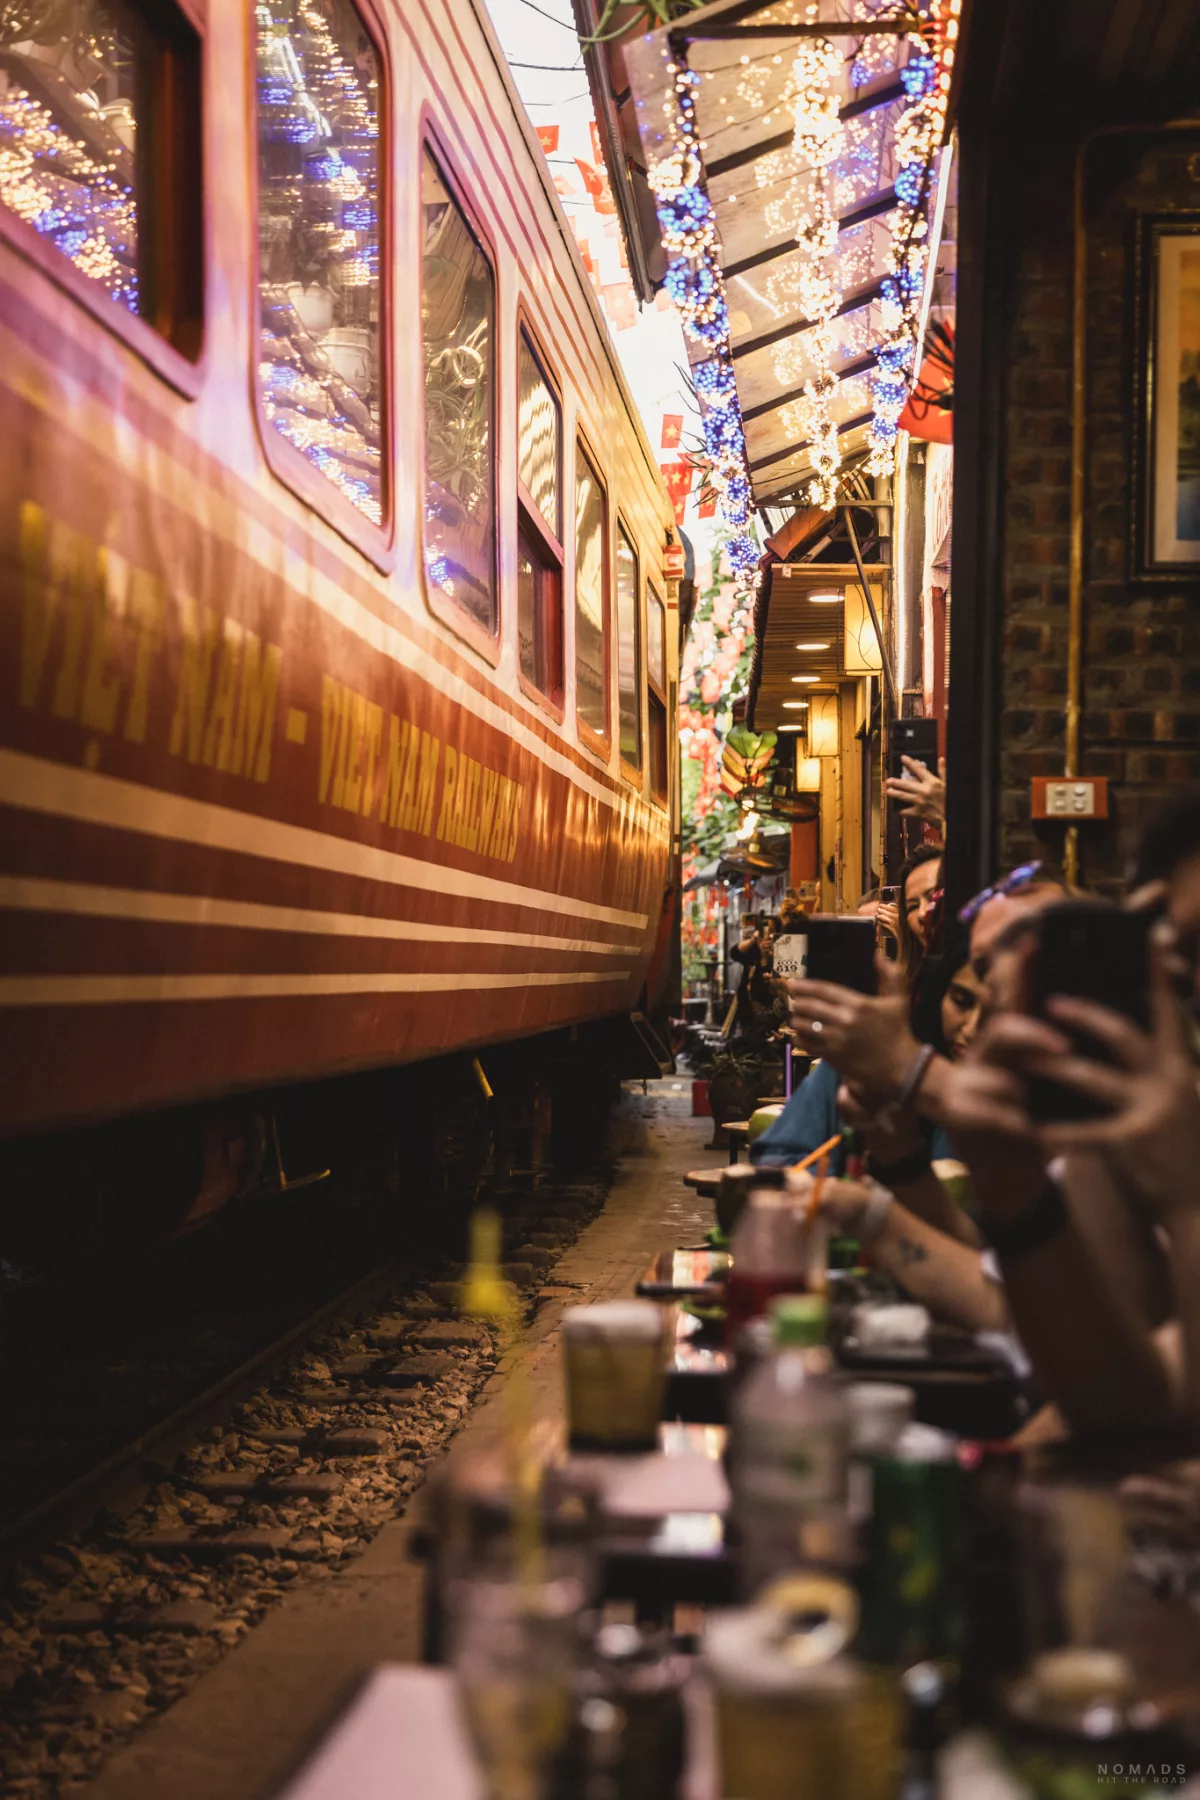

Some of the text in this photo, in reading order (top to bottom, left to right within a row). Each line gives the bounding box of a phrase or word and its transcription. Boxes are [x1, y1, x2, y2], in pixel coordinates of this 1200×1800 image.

[169, 591, 282, 784] NAM
[379, 713, 440, 837] NAM
[436, 744, 522, 864] RAILWAYS
